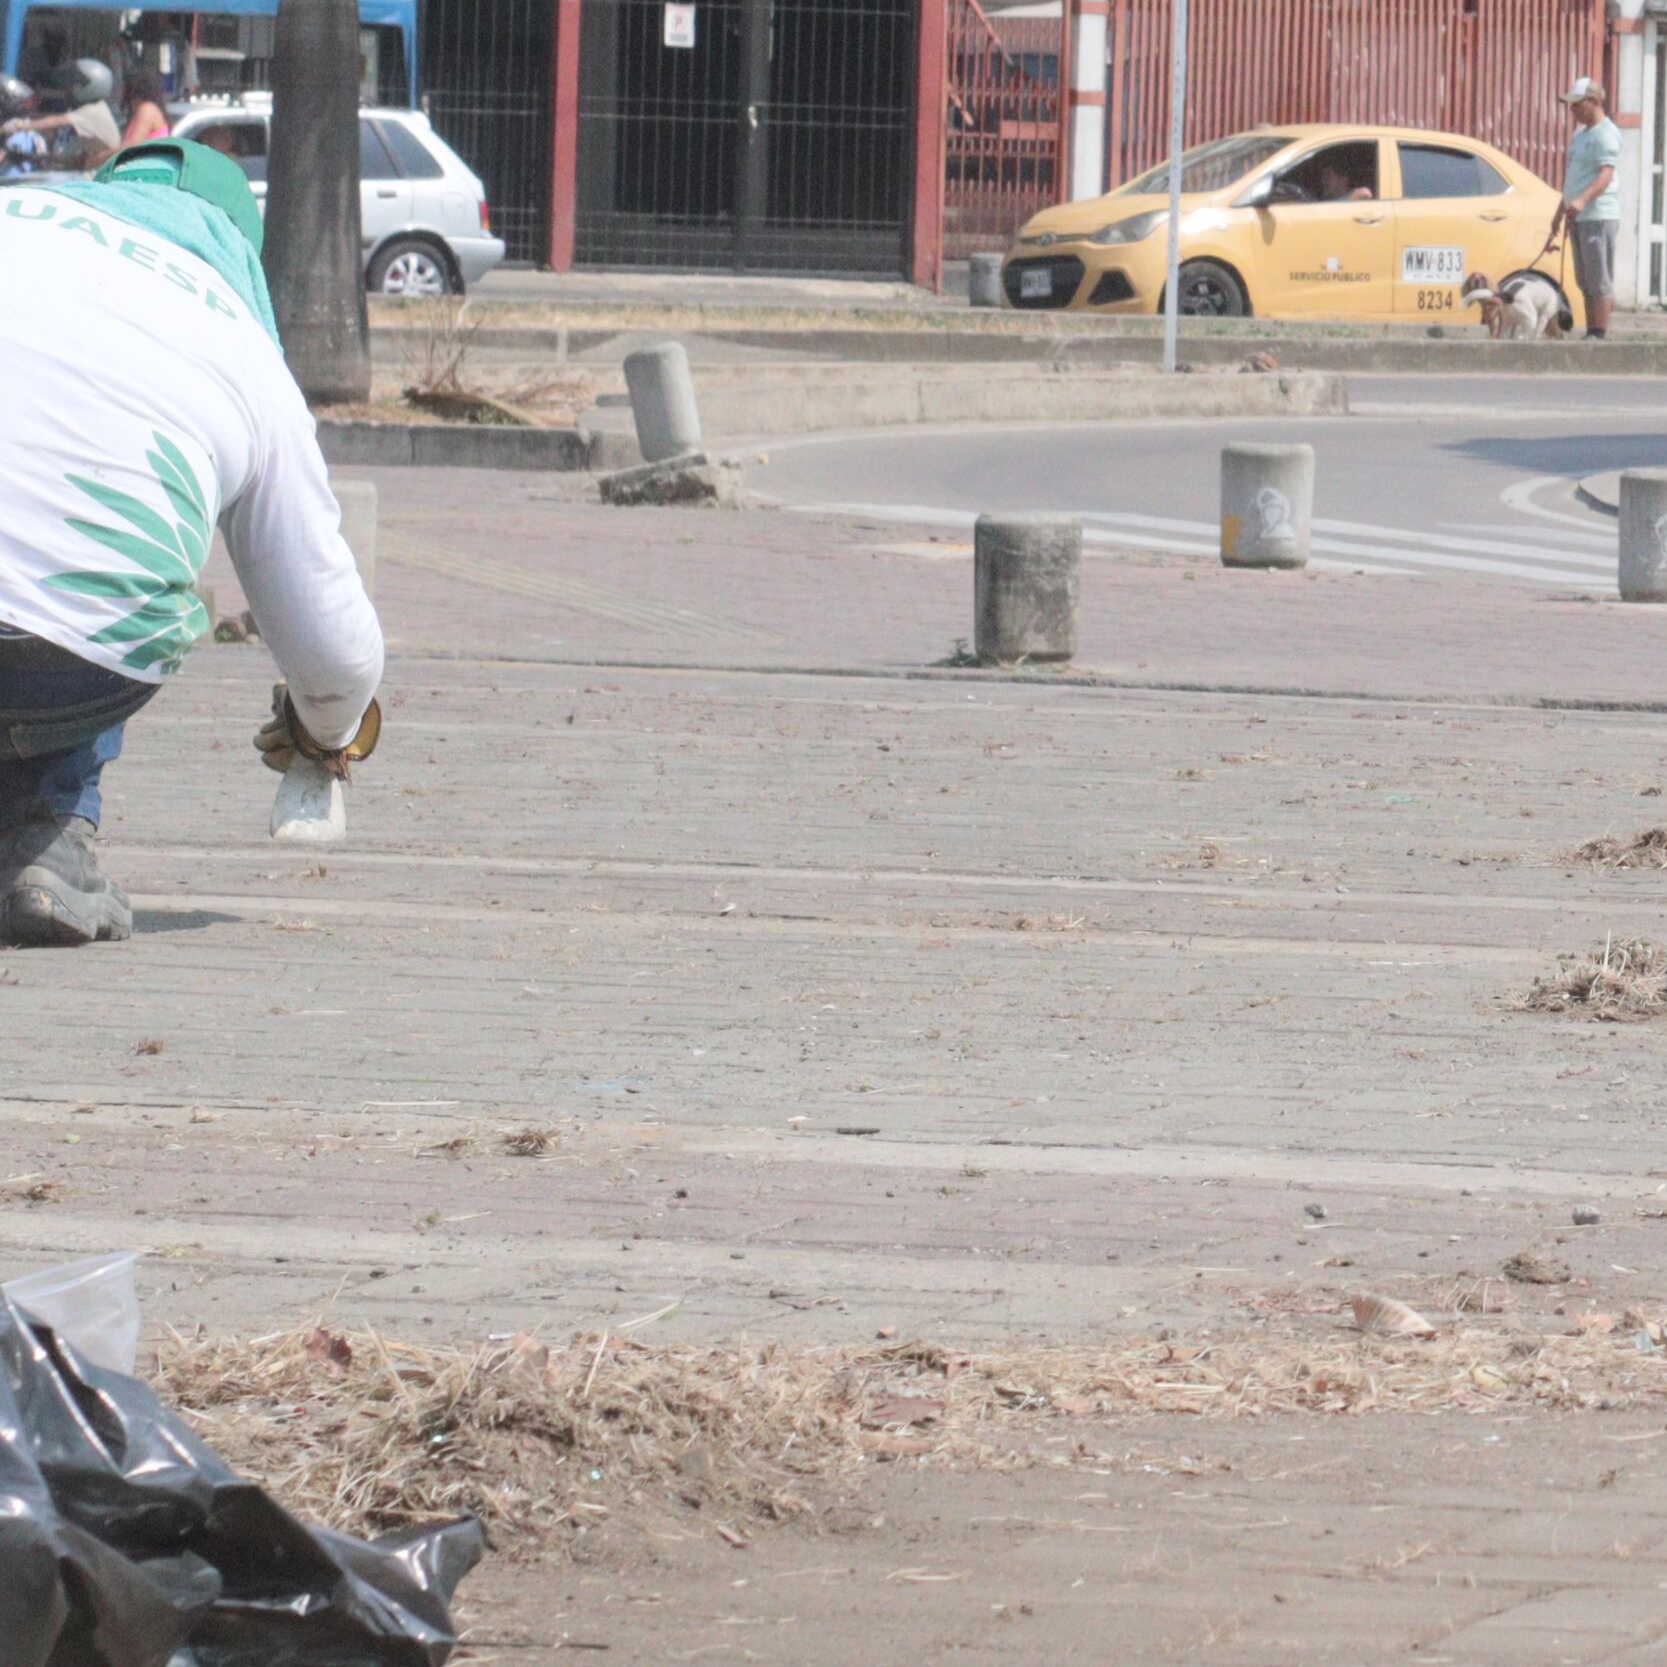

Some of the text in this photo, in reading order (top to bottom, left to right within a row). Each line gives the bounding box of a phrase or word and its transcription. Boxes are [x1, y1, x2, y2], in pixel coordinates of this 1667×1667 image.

[5, 199, 238, 320] UAESP
[1289, 271, 1331, 282] SERVICIO
[1417, 290, 1453, 310] 8234
